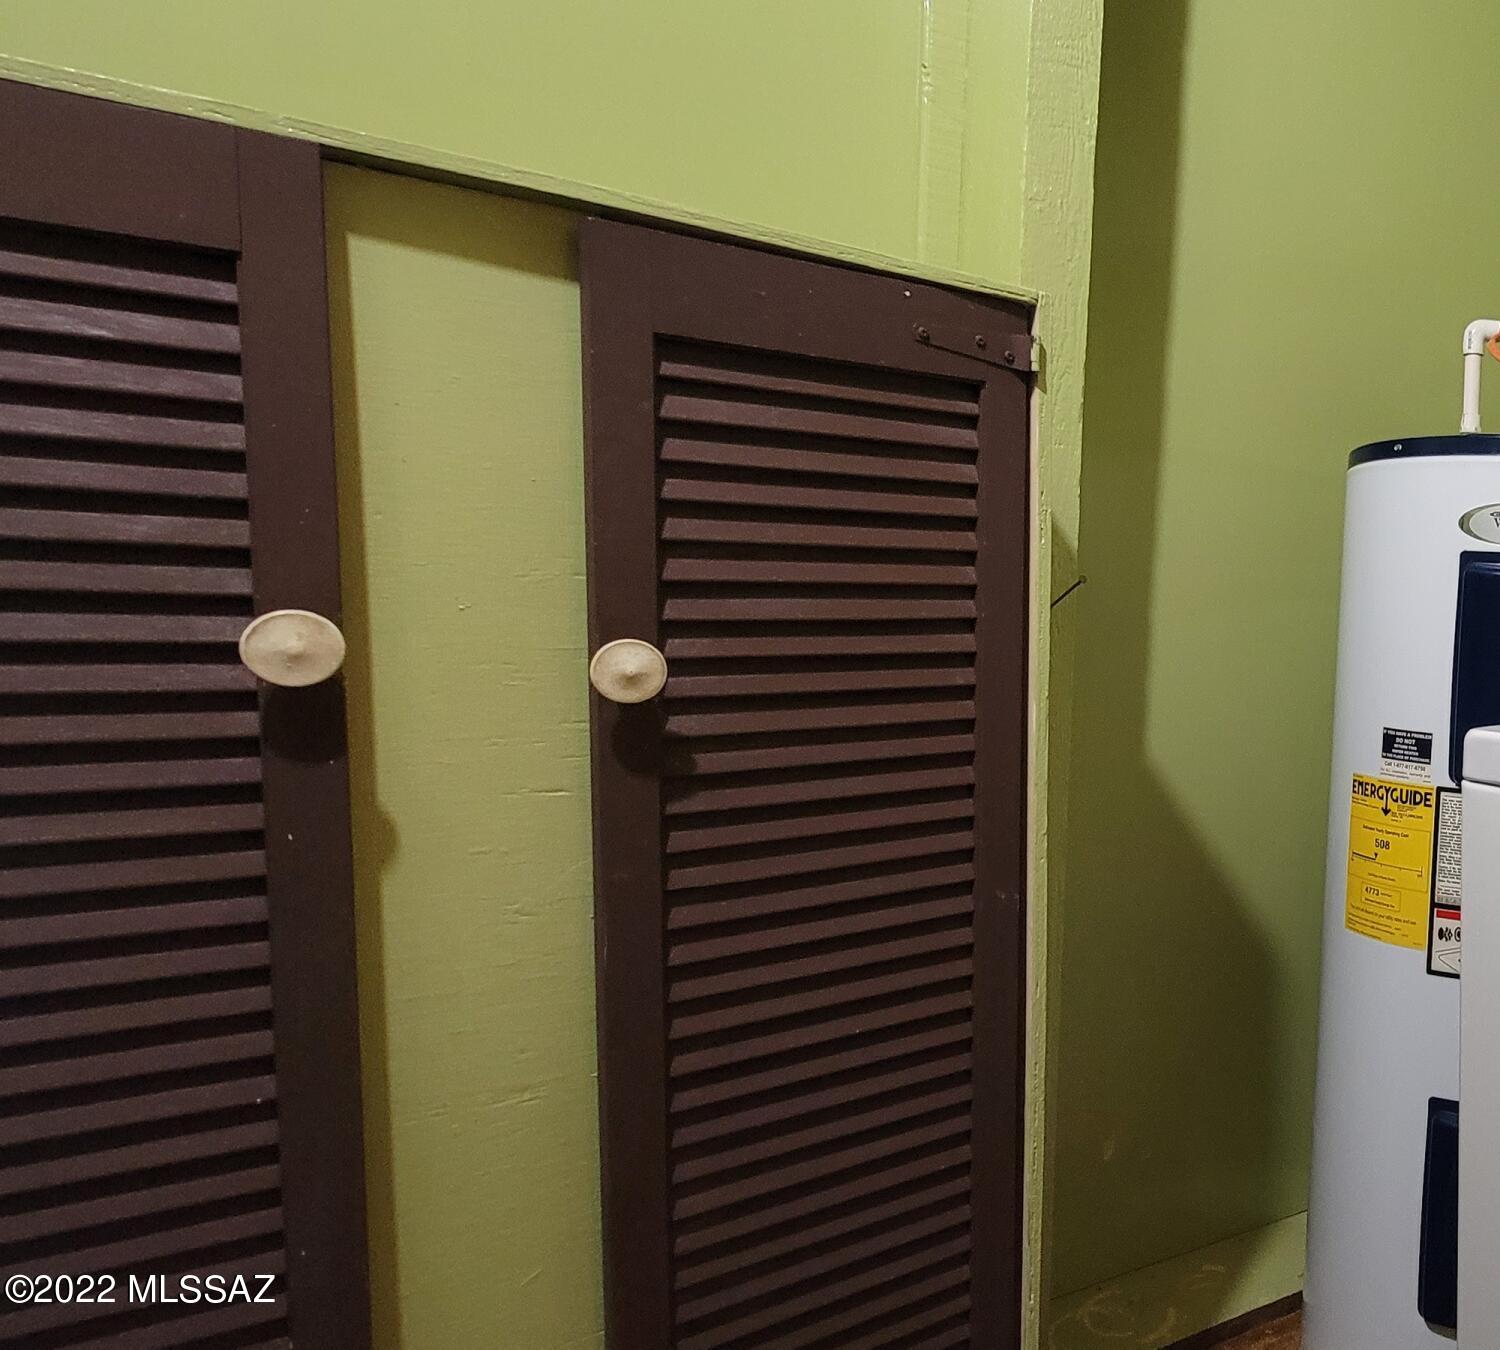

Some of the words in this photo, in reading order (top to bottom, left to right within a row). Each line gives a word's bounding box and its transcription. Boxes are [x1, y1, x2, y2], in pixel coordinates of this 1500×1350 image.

[1352, 779, 1432, 808] ENERGYGUIDE
[1375, 838, 1390, 850] 508
[1365, 886, 1380, 897] 4773
